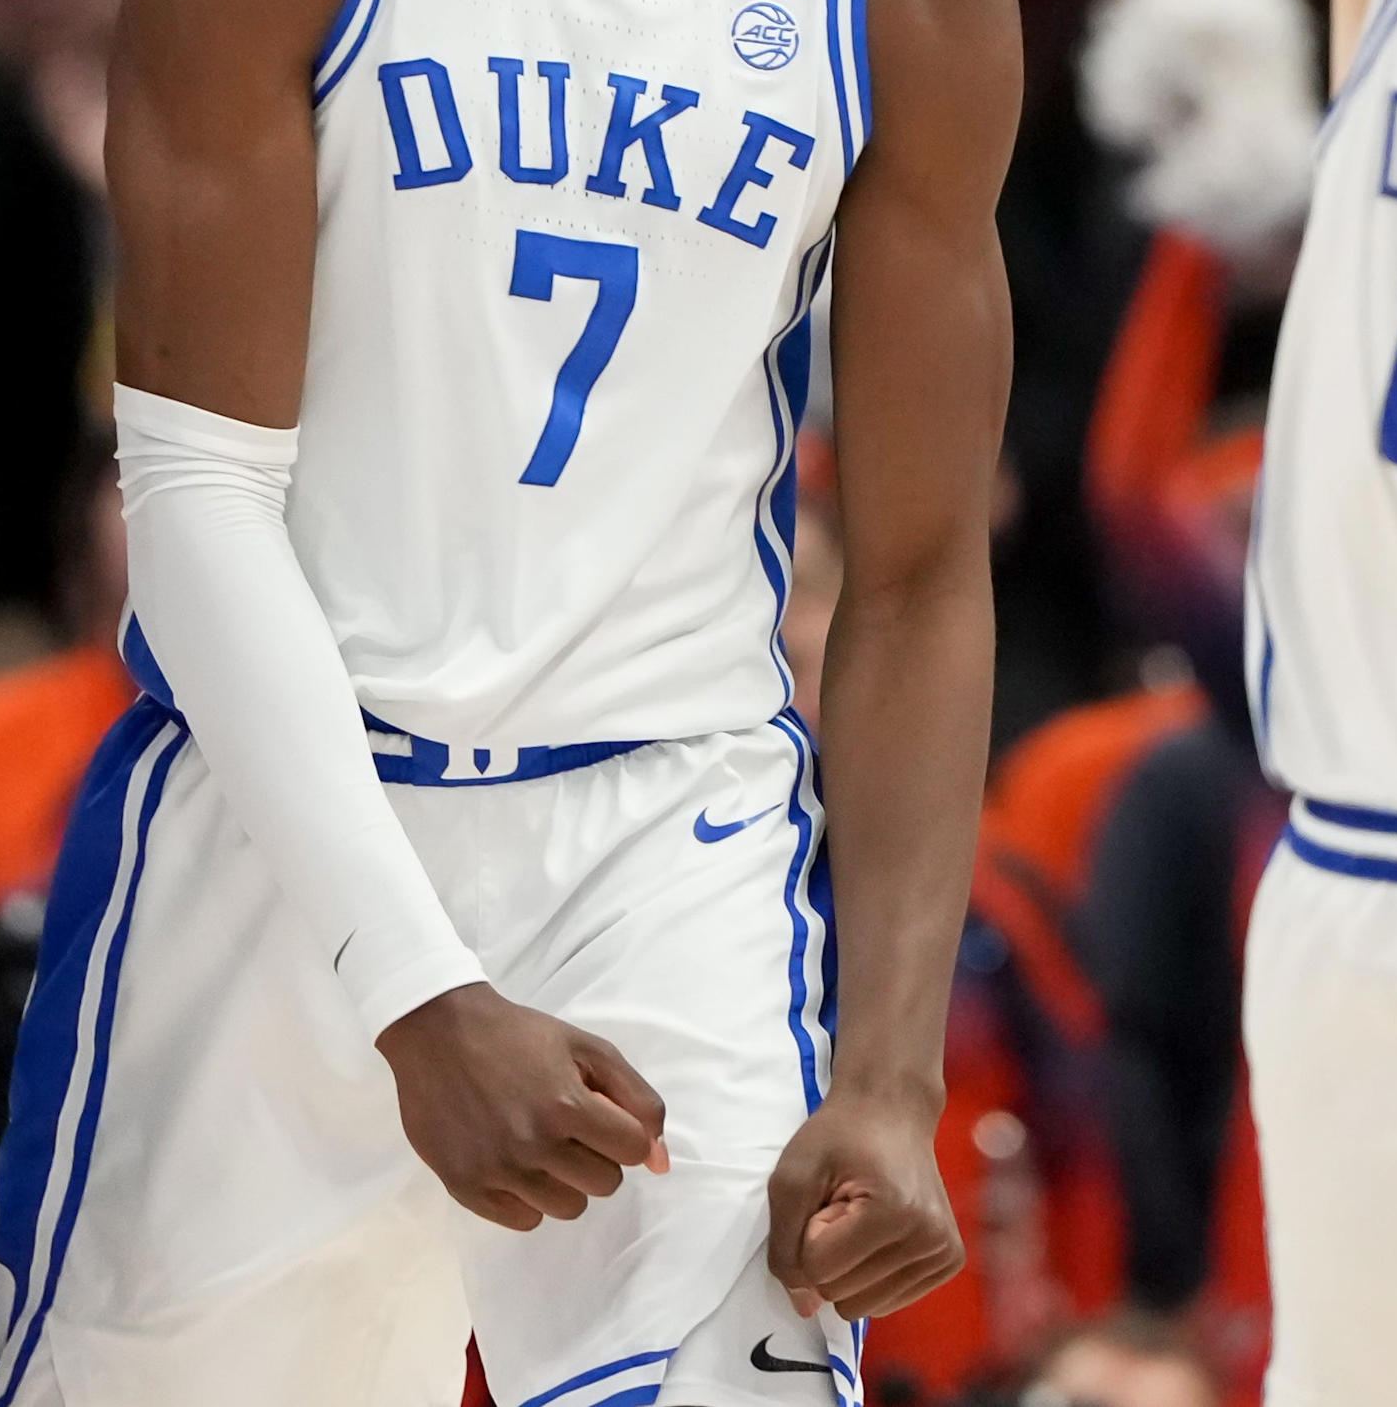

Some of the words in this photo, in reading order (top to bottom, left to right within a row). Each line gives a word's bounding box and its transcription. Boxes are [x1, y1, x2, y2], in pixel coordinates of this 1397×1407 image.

[740, 24, 796, 43] ACC
[378, 57, 816, 250] DUKE
[508, 229, 639, 487] 7
